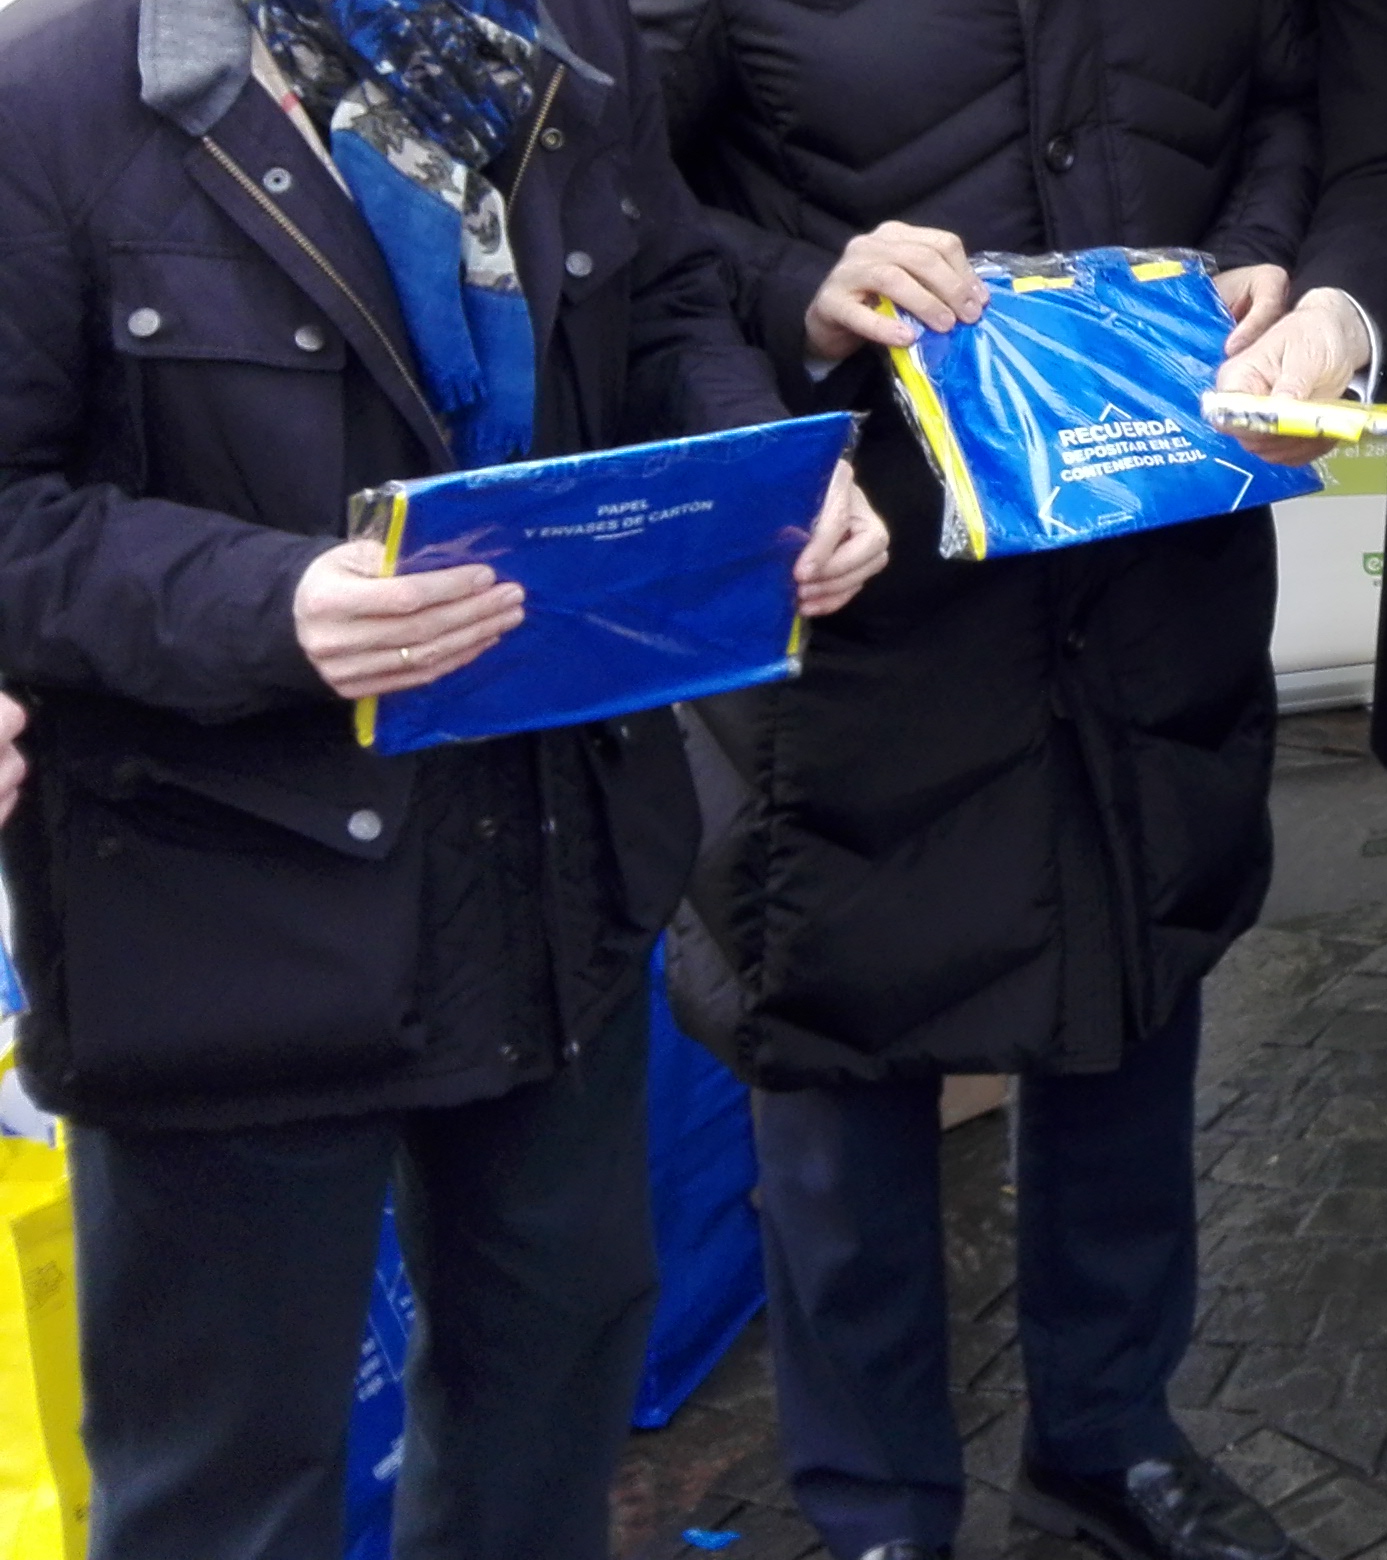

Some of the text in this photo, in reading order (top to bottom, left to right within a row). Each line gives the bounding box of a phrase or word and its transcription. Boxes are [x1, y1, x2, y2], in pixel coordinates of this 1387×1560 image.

[1058, 418, 1181, 447] RECUERDA
[1060, 449, 1207, 481] CONTENEDOR AZUL
[1062, 436, 1192, 465] DEPOSITAR EN EL
[524, 500, 714, 538] Y ENVASES DE CARTÓN
[598, 499, 648, 517] PAPEL
